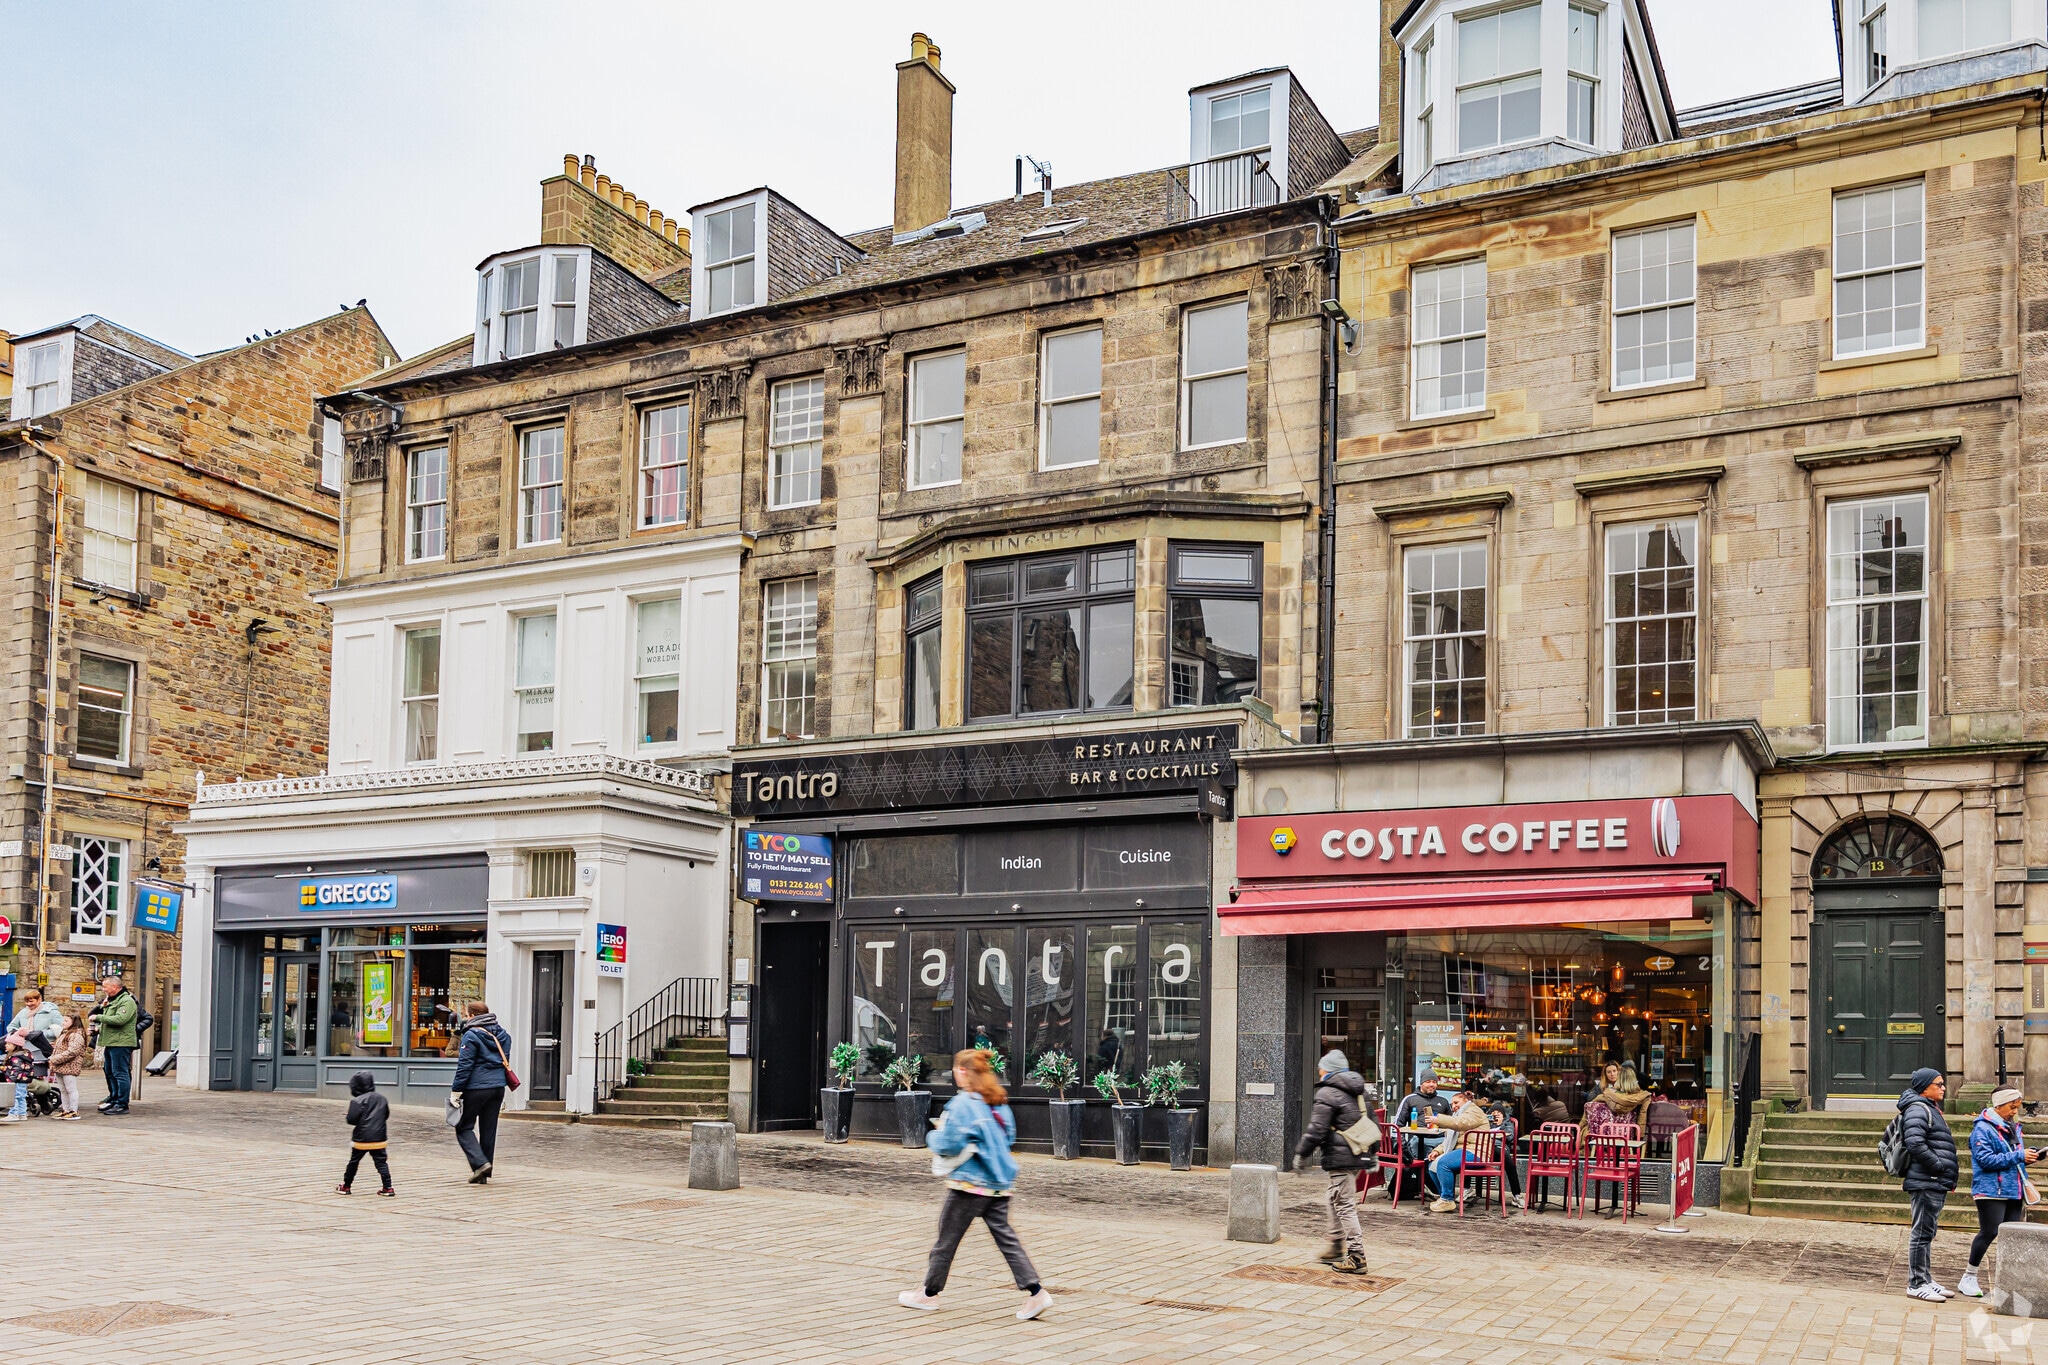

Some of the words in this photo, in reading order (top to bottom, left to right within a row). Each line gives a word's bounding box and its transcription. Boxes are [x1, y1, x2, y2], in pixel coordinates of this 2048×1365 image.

[1075, 735, 1216, 759] RESTAURANT
[1070, 771, 1101, 785] BAR
[1109, 769, 1118, 782] &
[1125, 763, 1220, 781] COCKTAILS
[740, 770, 837, 802] Tantra
[1208, 790, 1226, 807] Tantra
[747, 833, 801, 853] EYCO
[1320, 825, 1447, 862] COSTA
[1461, 817, 1629, 854] COFFEE
[49, 851, 71, 859] TREET
[747, 852, 762, 861] TO
[787, 855, 809, 865] MAY
[810, 857, 831, 866] SELL
[1119, 849, 1172, 864] Cuisine
[747, 863, 762, 871] Fully
[780, 865, 812, 873] Restaurant
[1001, 856, 1042, 870] Indian
[1870, 860, 1885, 871] 13
[769, 879, 787, 888] 0131
[789, 880, 804, 889] 226
[804, 882, 823, 890] 2641
[318, 881, 392, 904] GREGGS
[769, 888, 824, 897] www.eyco.co.uk
[600, 964, 610, 973] TO
[610, 966, 623, 974] LET
[864, 938, 1192, 988] Tantra
[1442, 1025, 1455, 1033] UP
[1423, 1038, 1459, 1046] TOASTIE
